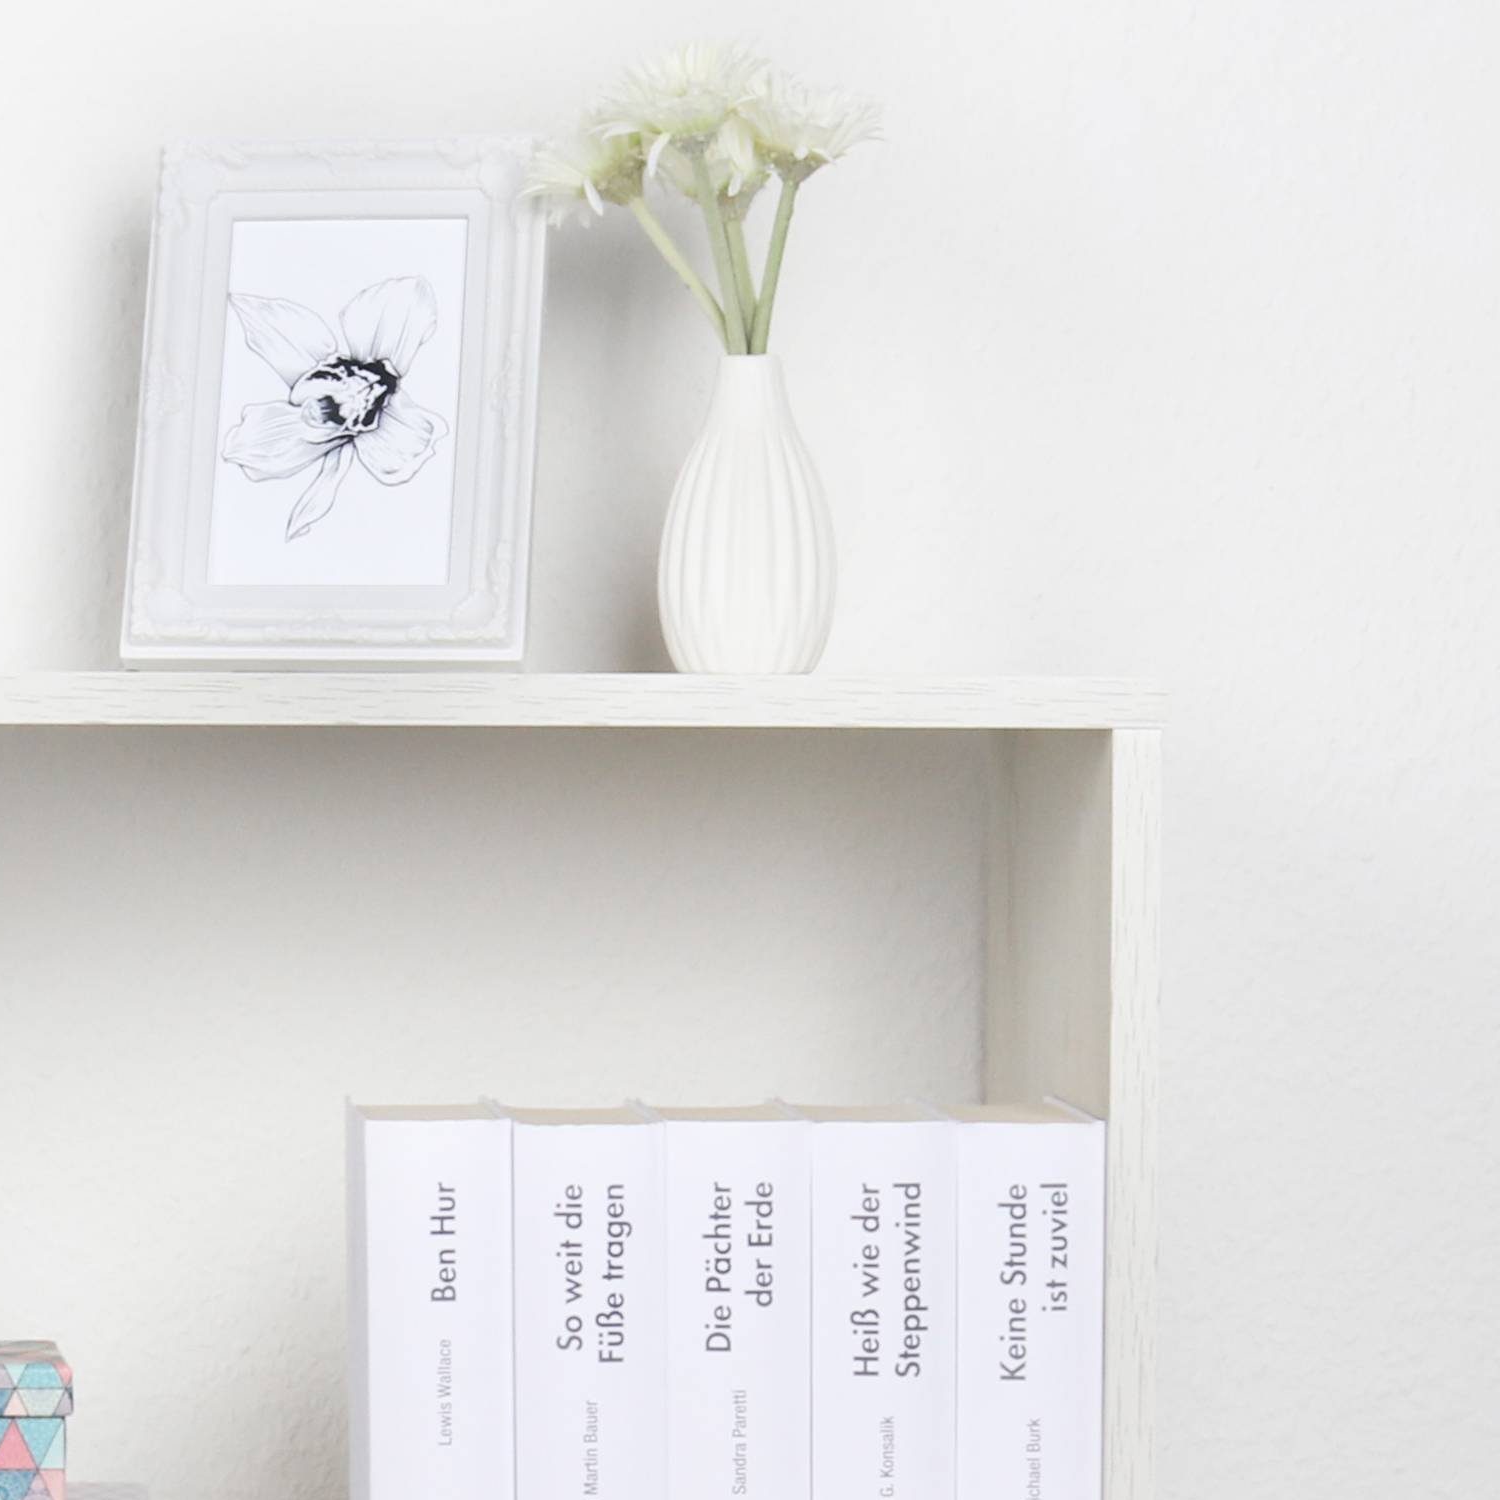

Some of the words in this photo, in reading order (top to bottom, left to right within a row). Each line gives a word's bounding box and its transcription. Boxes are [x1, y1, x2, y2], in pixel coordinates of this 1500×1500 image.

[430, 1183, 455, 1235] Hur
[554, 1185, 582, 1229] die
[602, 1185, 632, 1280] tragen
[744, 1183, 773, 1247] Erde
[851, 1184, 879, 1232] der
[1040, 1184, 1068, 1268] zuviel
[703, 1182, 731, 1292] Pächter
[998, 1185, 1027, 1285] Stunde
[431, 1250, 456, 1301] Ben
[556, 1240, 583, 1303] weit
[745, 1259, 773, 1307] der
[853, 1245, 879, 1297] wie
[893, 1183, 928, 1377] Steppenwind
[1042, 1280, 1067, 1311] ist
[556, 1316, 583, 1350] So
[595, 1293, 624, 1362] Füße
[705, 1306, 731, 1352] Die
[850, 1309, 879, 1376] Heiß
[1000, 1299, 1026, 1380] Keine
[438, 1339, 452, 1398] Wallace
[438, 1402, 452, 1445] Lewis
[583, 1400, 598, 1443] Bauer
[732, 1390, 746, 1437] Paretti
[1026, 1419, 1041, 1452] Burk
[584, 1449, 598, 1495] Martin
[732, 1443, 747, 1494] Sandra
[880, 1417, 894, 1477] Konsalik
[879, 1484, 894, 1497] G.
